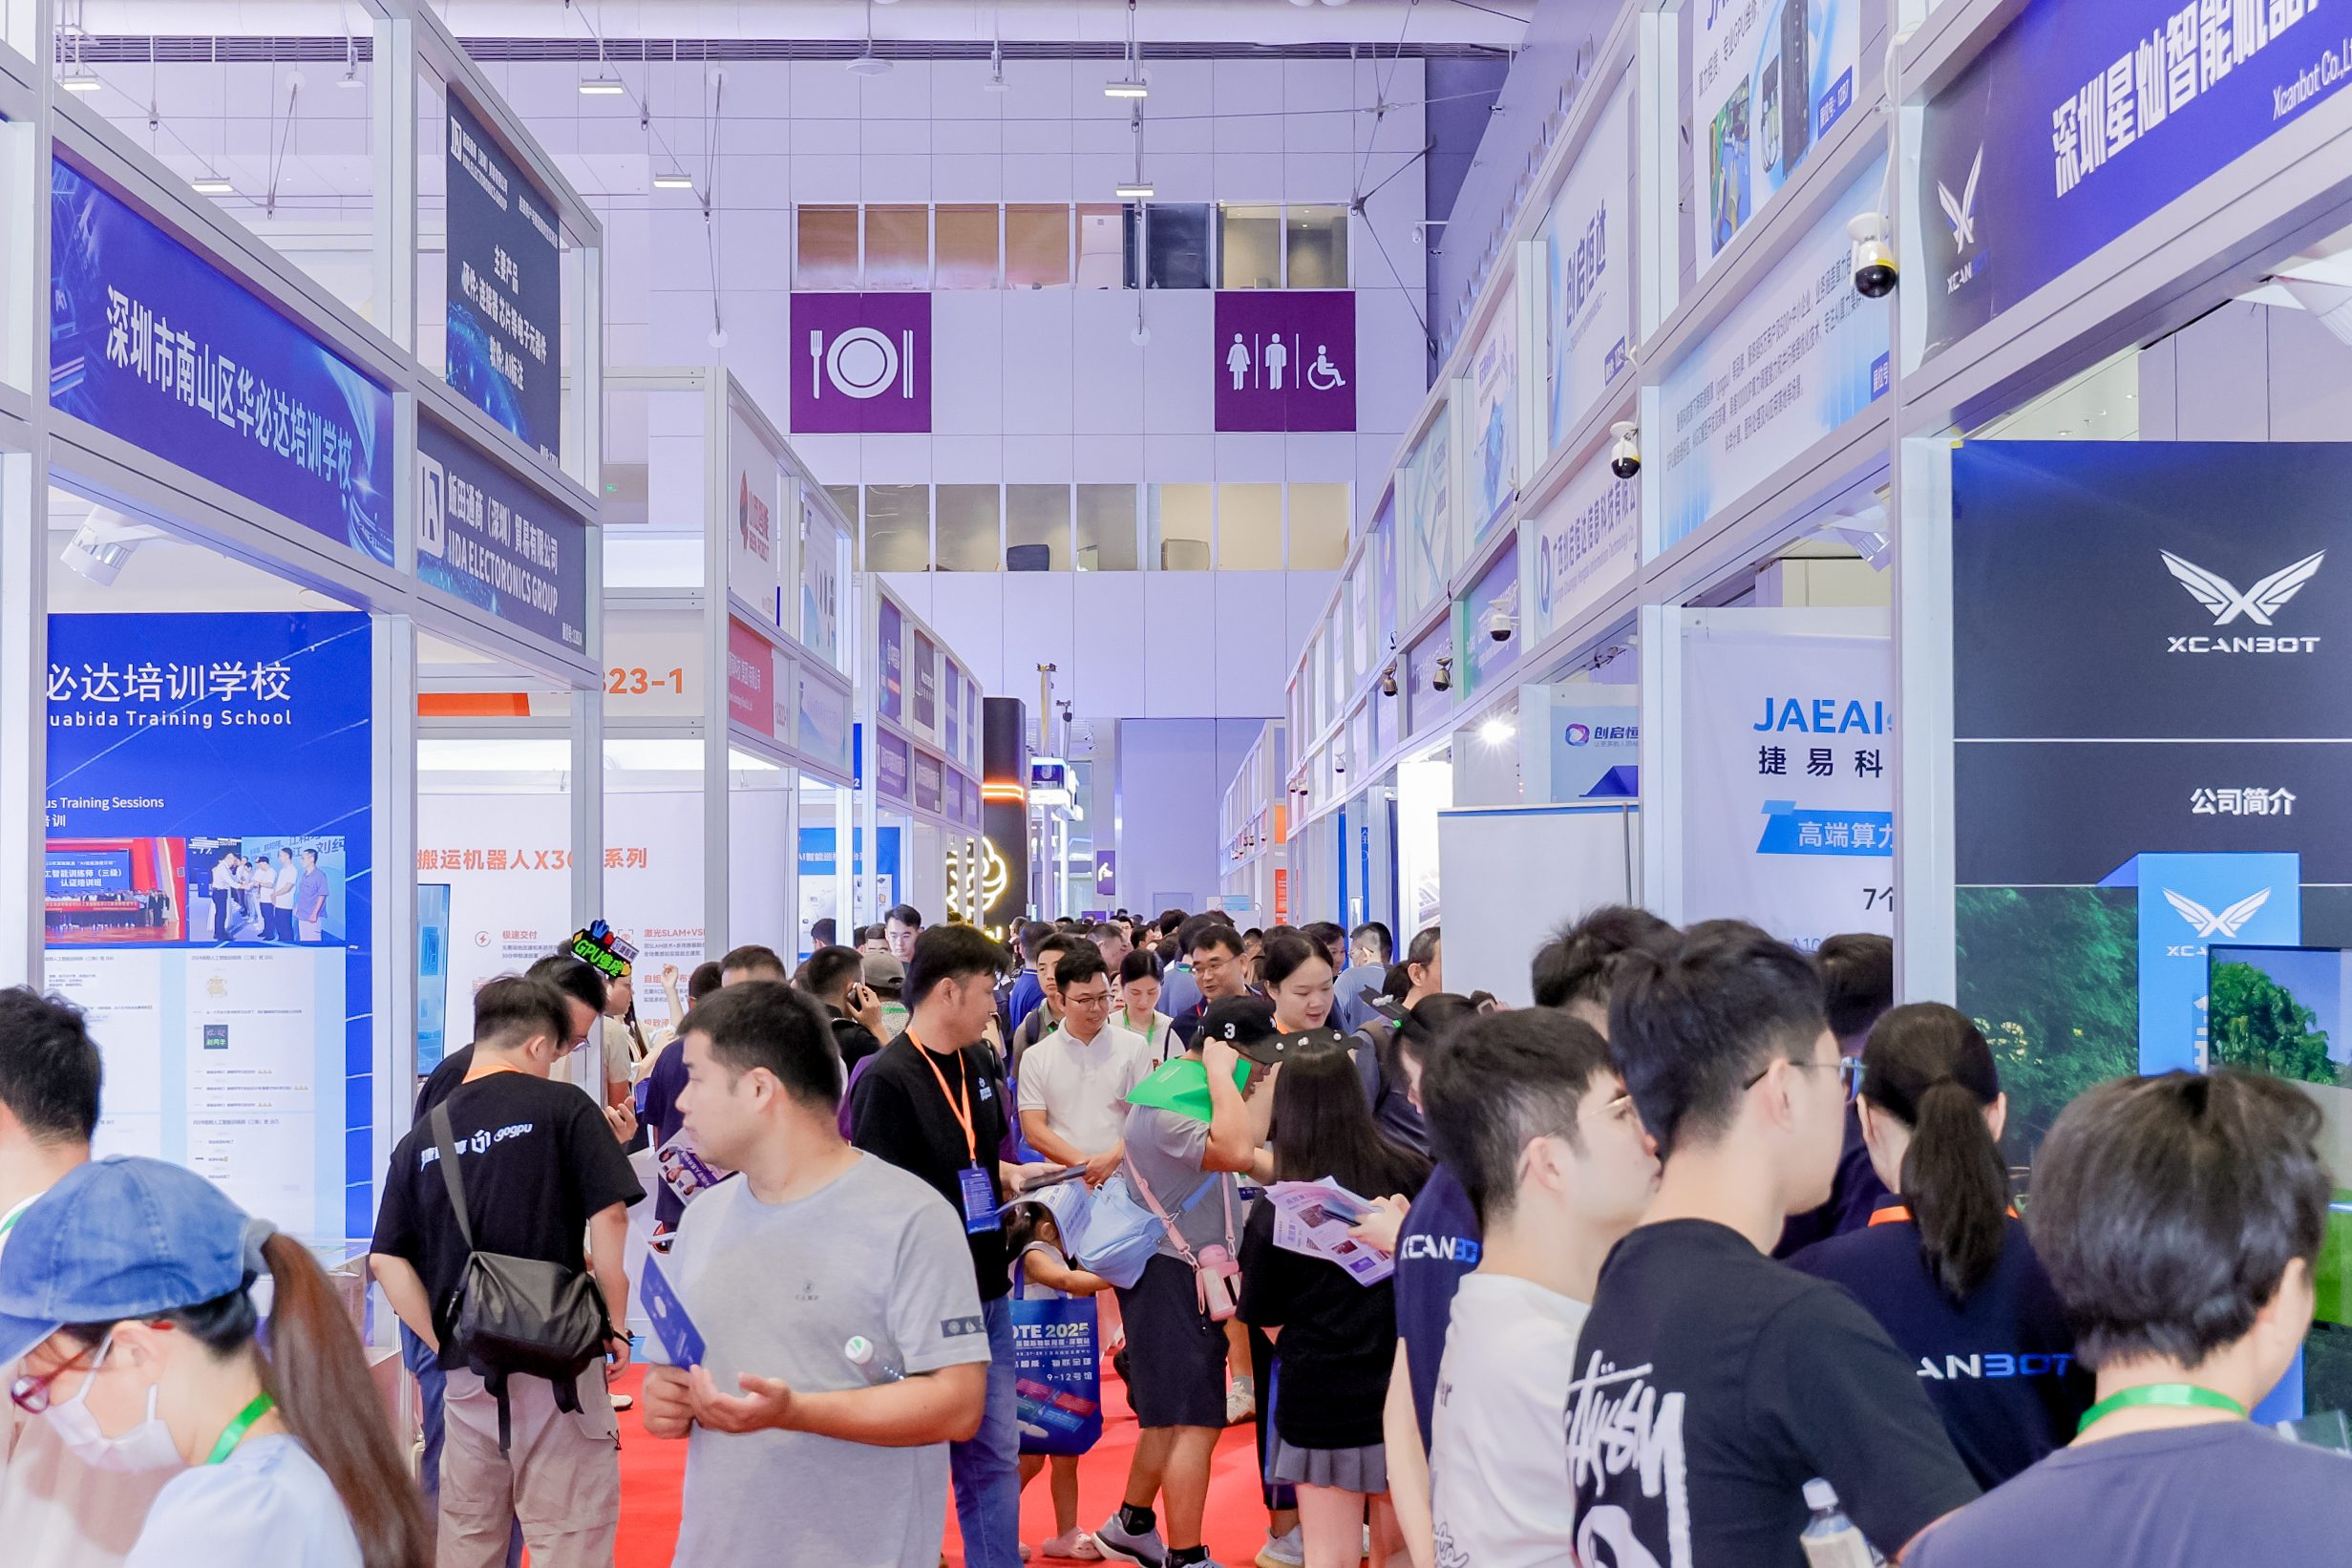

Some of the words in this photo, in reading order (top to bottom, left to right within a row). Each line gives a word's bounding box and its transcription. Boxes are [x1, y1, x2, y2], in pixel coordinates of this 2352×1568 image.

[2273, 63, 2320, 121] Xcanbot
[494, 244, 519, 295] 主要产品
[107, 285, 351, 492] 深圳市南山区华必达培训学校
[469, 540, 531, 604] ELECTORONICS
[532, 576, 559, 616] GROUP
[2167, 637, 2321, 653] XCANBOT
[46, 661, 291, 702] 必达培训学校
[603, 667, 684, 694] 23-1
[50, 711, 118, 726] uabida
[126, 710, 213, 729] Training
[221, 710, 292, 726] School
[1753, 697, 1893, 734] JAEAI
[1758, 746, 1883, 777] 捷易科
[60, 797, 110, 811] Training
[113, 796, 164, 809] Sessions
[2190, 787, 2297, 816] 公司简介
[1224, 1023, 1236, 1039] 3
[494, 1123, 534, 1142] gogpu
[1045, 1322, 1090, 1338] 2025
[1047, 1371, 1092, 1382] 9-12号馆
